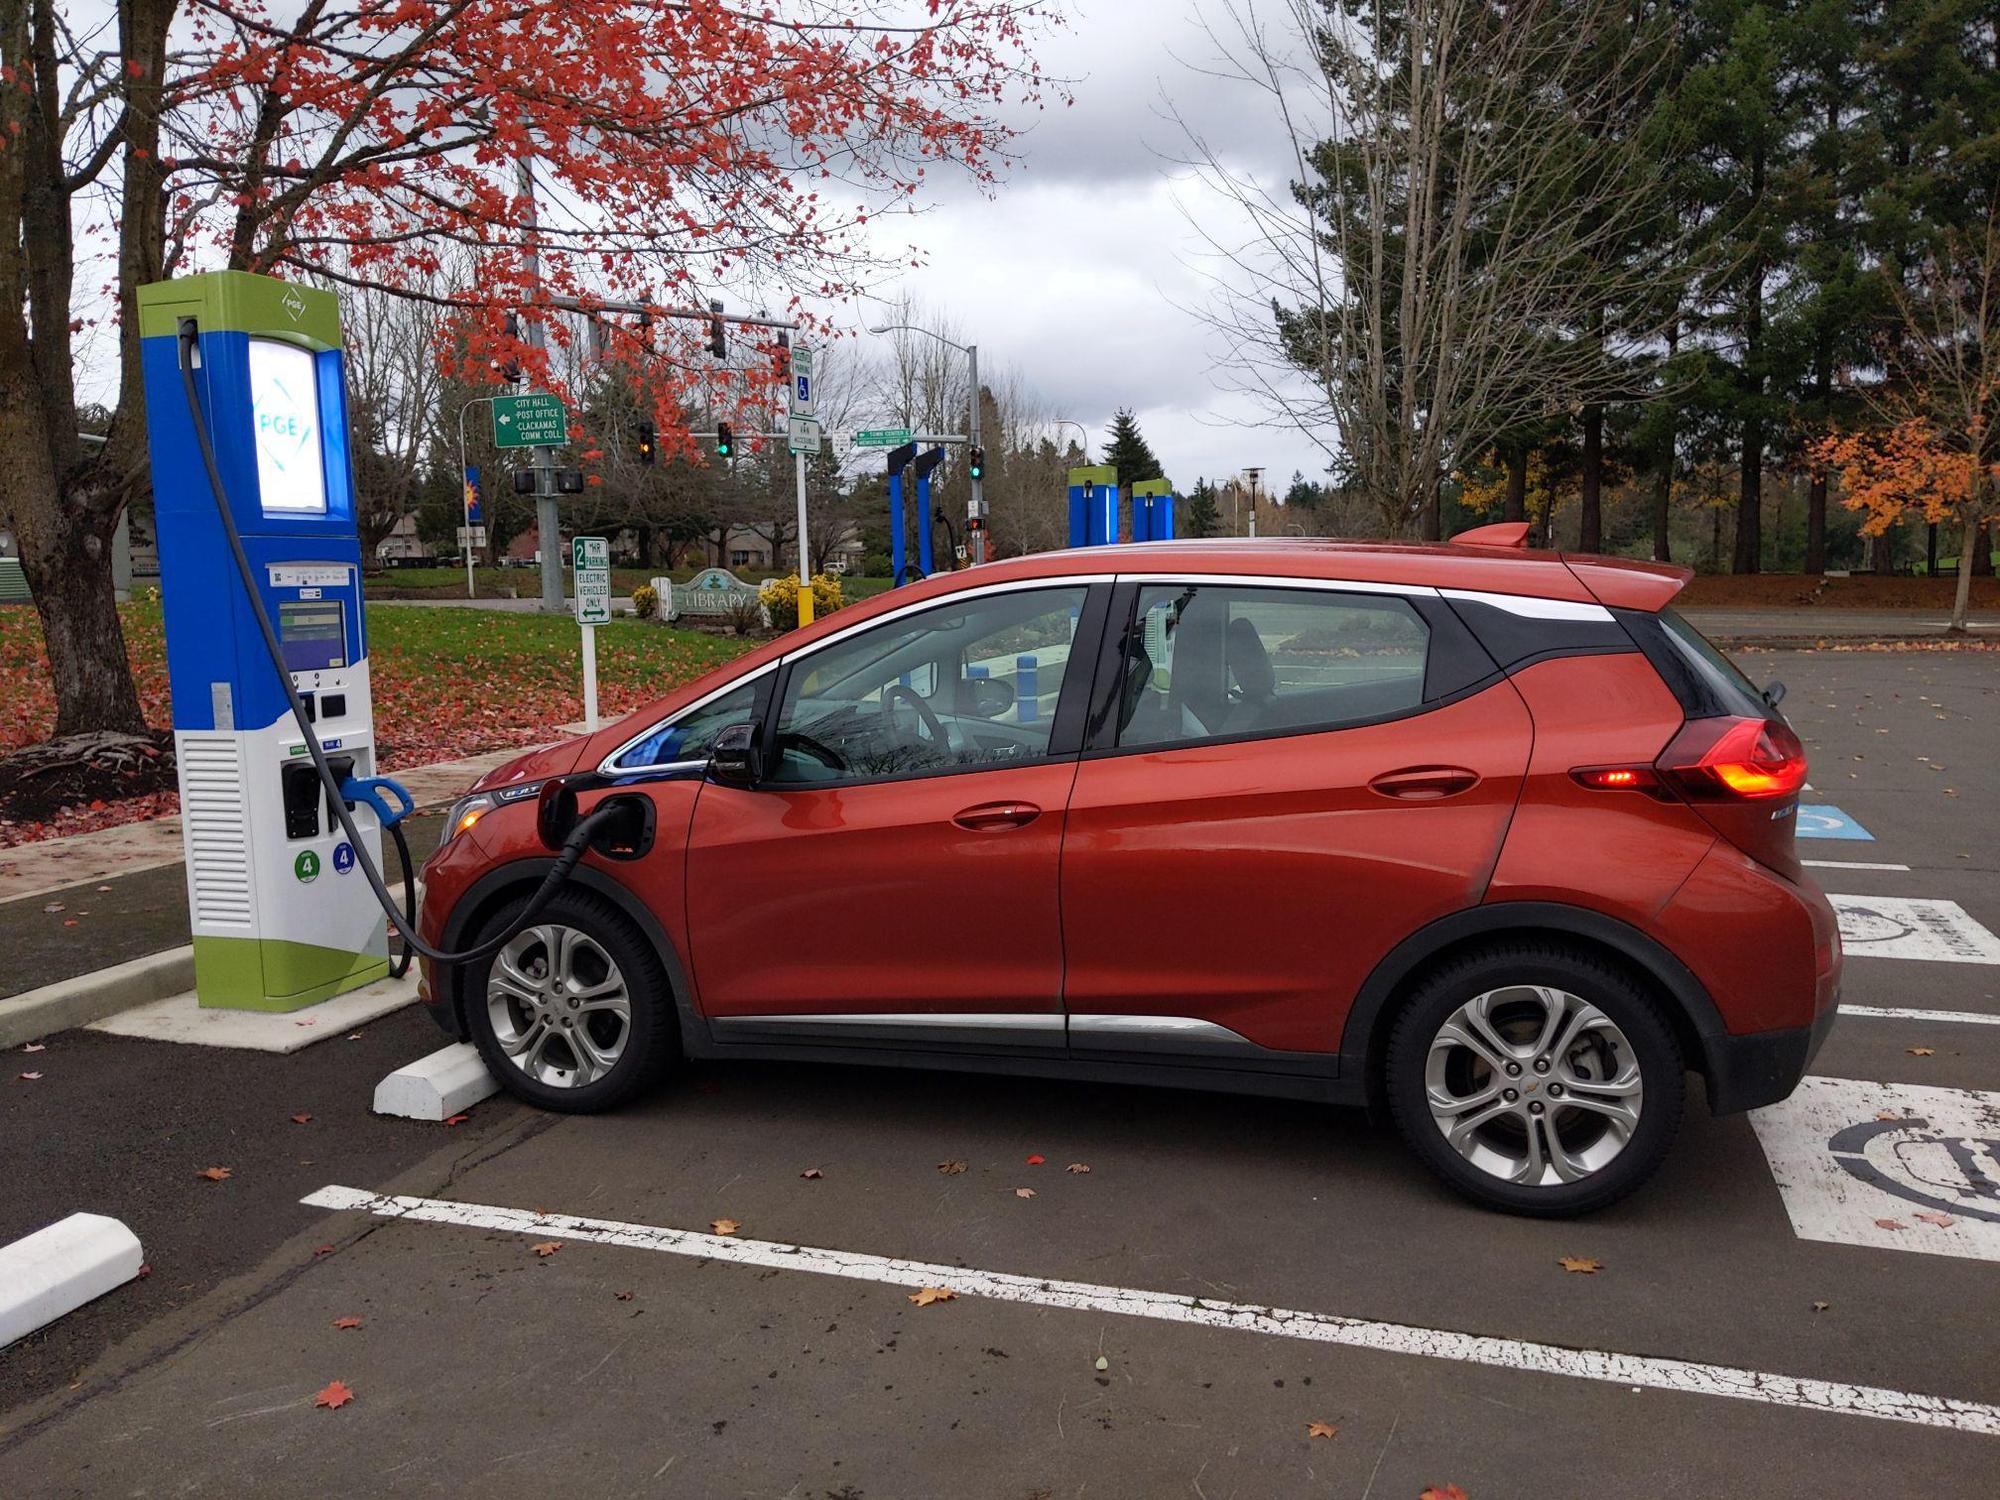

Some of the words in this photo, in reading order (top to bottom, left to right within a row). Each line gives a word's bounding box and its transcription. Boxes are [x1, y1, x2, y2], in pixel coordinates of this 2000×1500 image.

[516, 399, 530, 408] CITY
[532, 398, 550, 407] HALL
[517, 410, 535, 420] POST
[535, 408, 559, 418] OFFICE
[260, 414, 298, 437] PGE
[518, 420, 557, 431] CLACKAMAS
[576, 544, 584, 566] 2
[585, 556, 607, 567] PARKING
[579, 573, 606, 583] ELECTRIC
[579, 586, 607, 596] VEHICLES
[585, 598, 601, 608] ONLY
[685, 592, 747, 608] LIBRARY
[340, 850, 349, 865] 4
[302, 857, 313, 873] 4
